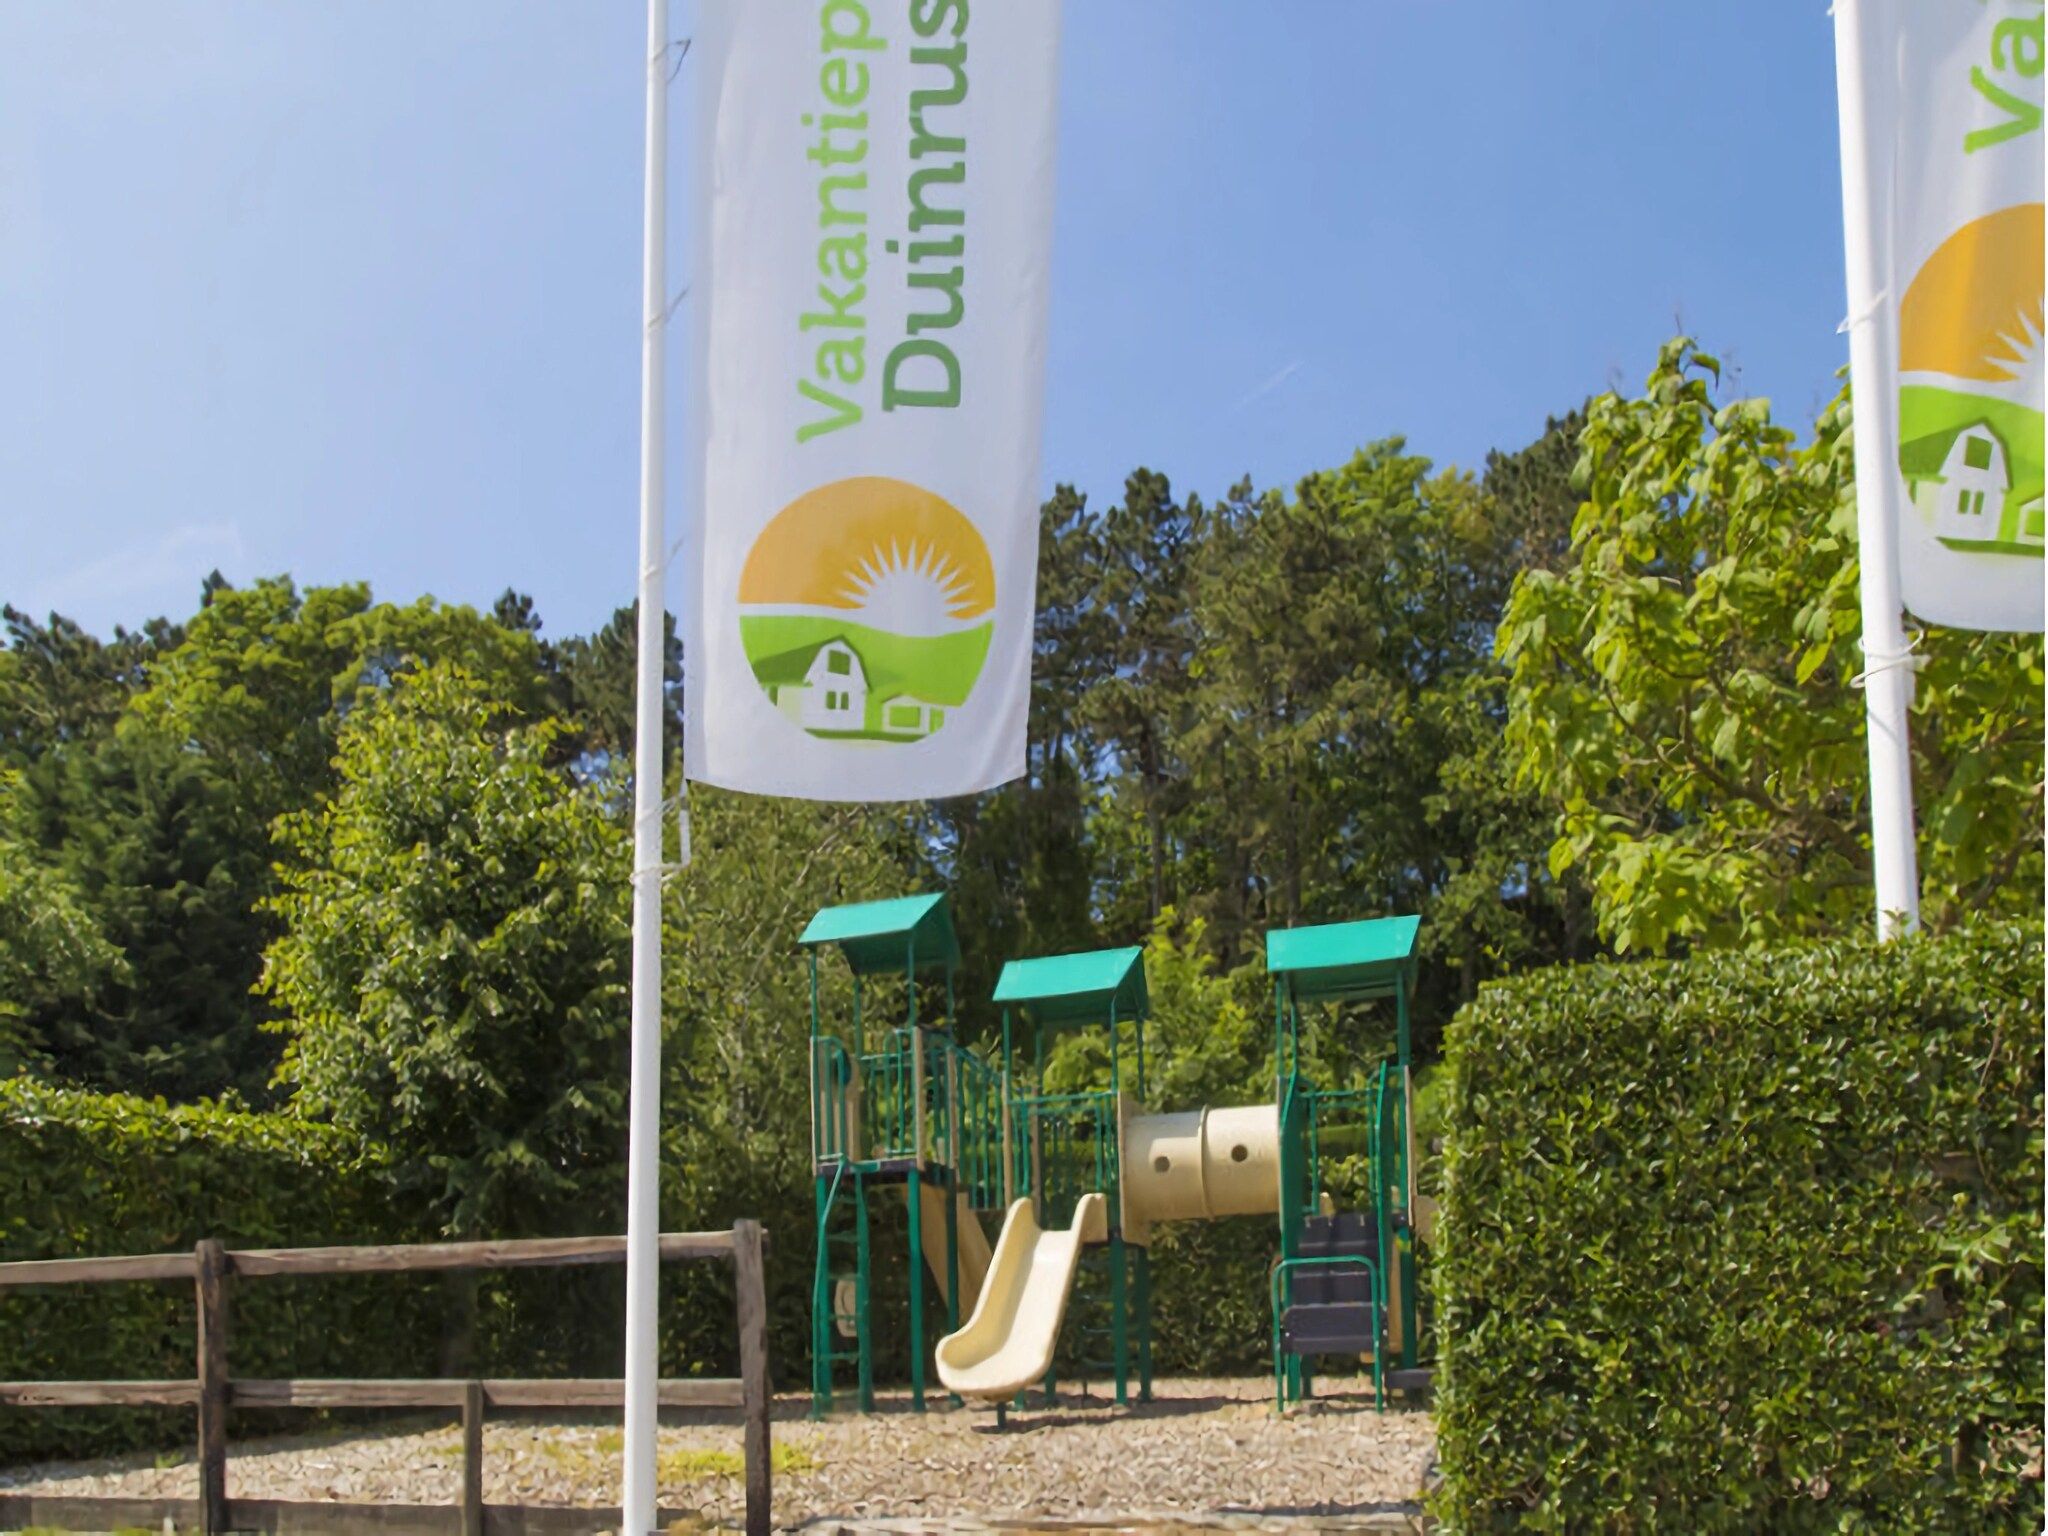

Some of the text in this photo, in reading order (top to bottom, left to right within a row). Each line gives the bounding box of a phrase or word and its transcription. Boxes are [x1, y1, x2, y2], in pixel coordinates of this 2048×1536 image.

[796, 0, 888, 444] Vakantiep
[882, 0, 969, 412] Duinrus
[1963, 0, 2045, 155] Va
